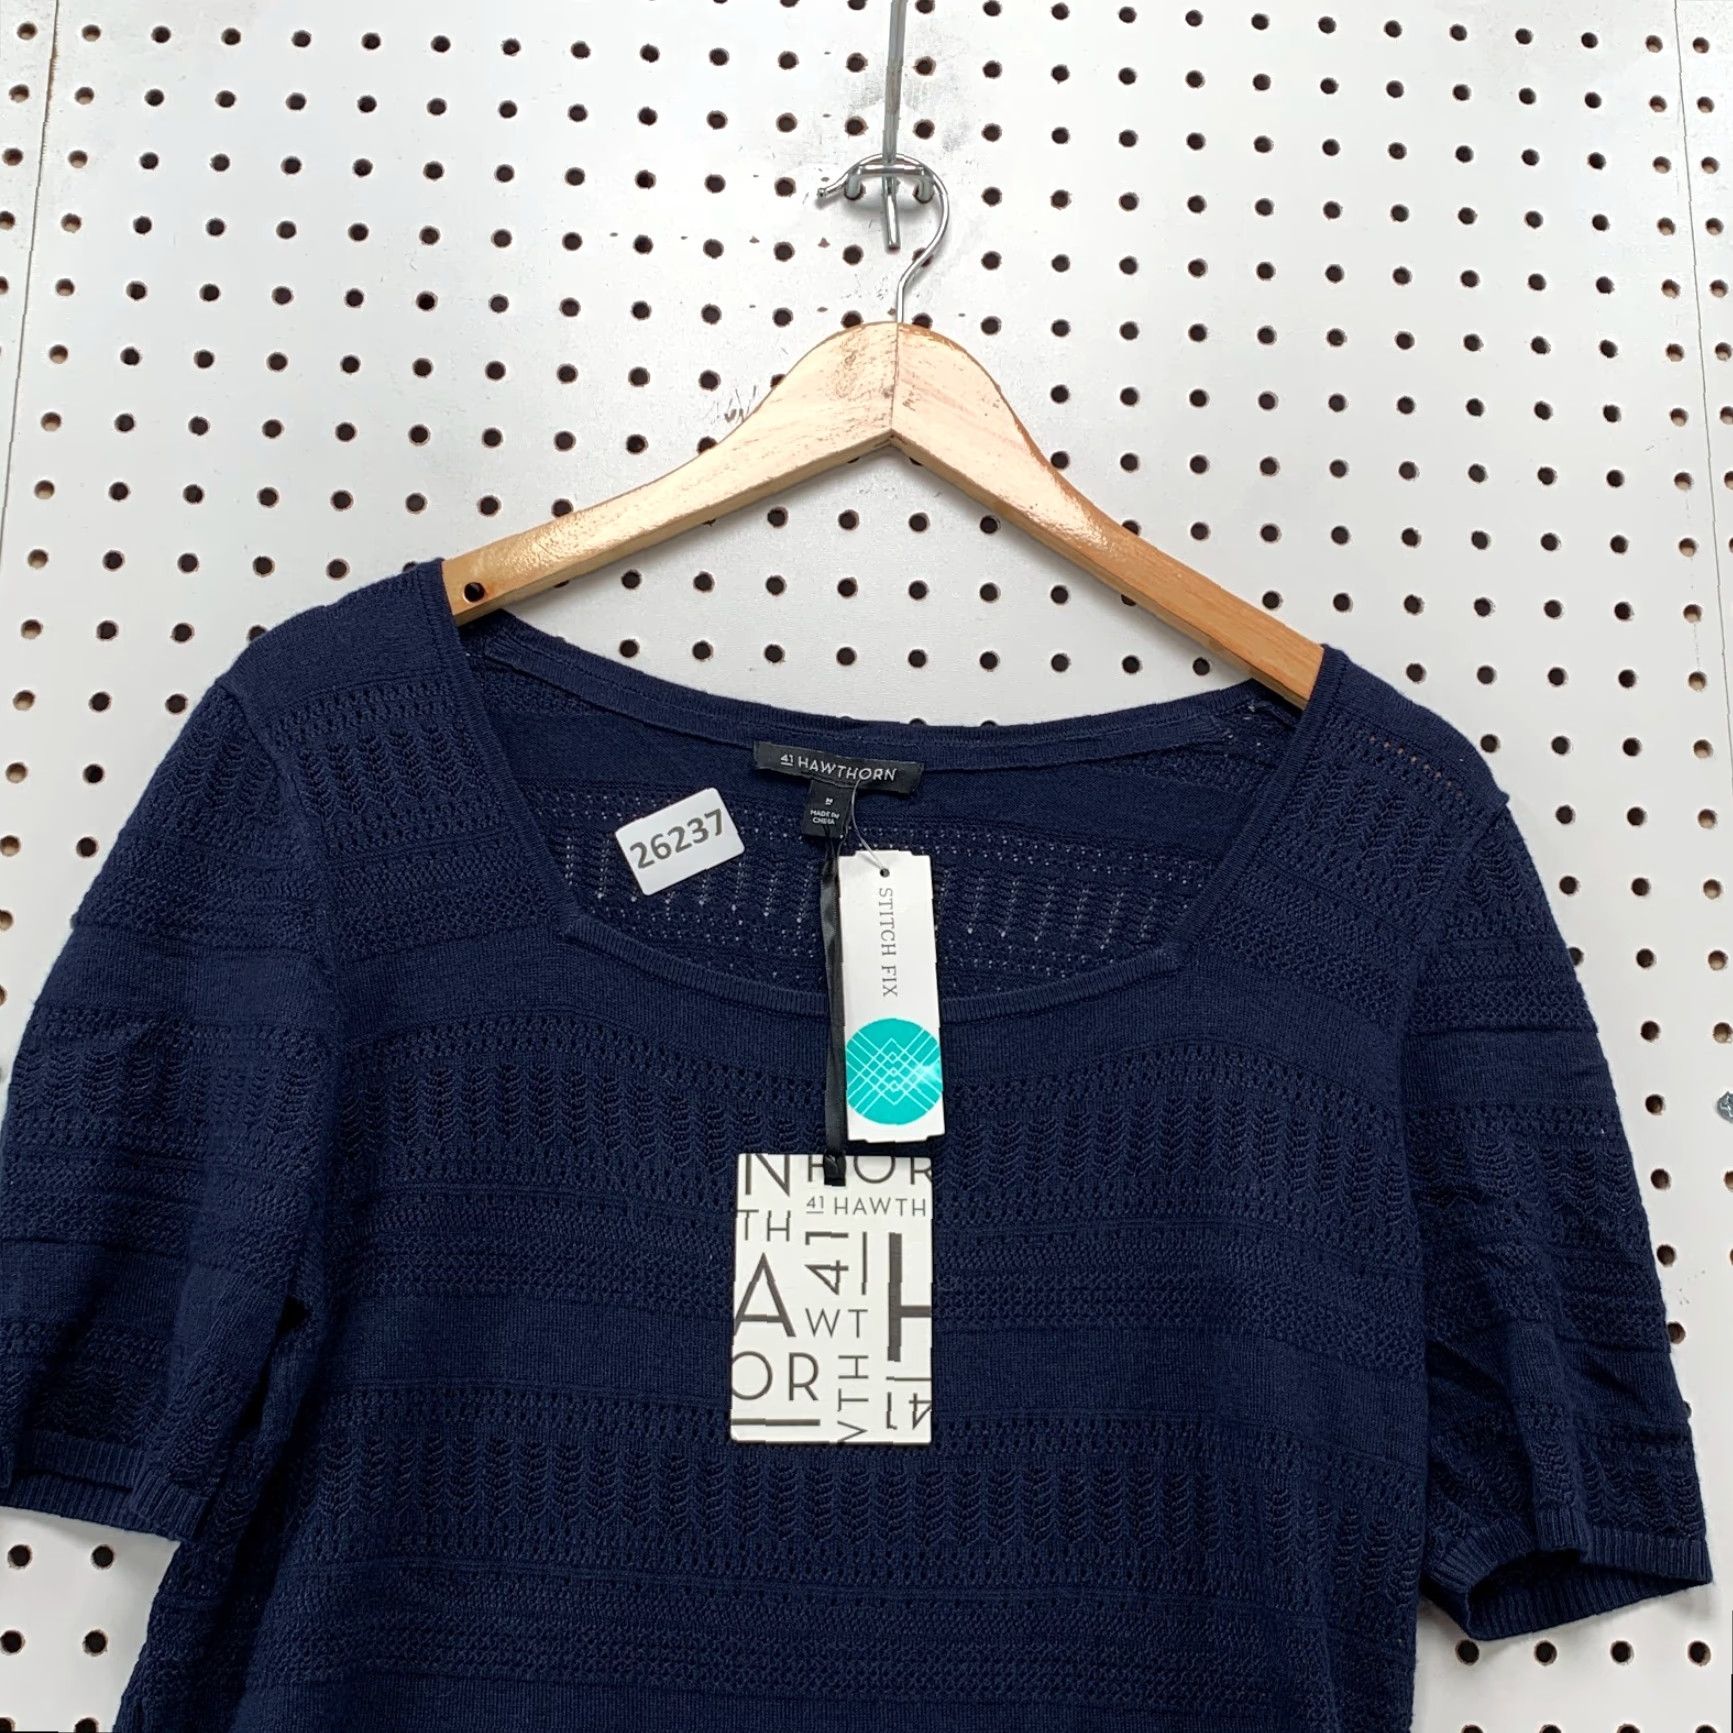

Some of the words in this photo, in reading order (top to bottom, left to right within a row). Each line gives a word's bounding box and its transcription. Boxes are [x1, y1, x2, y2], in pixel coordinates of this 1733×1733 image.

[780, 754, 794, 765] 41
[797, 756, 897, 782] HAWTHORN
[810, 809, 830, 818] MADE
[629, 808, 723, 870] 26237
[878, 887, 897, 956] STITCH
[881, 962, 898, 998] FIX
[806, 1195, 824, 1211] 41
[833, 1196, 926, 1217] HAWTH
[736, 1209, 792, 1242] TH
[734, 1251, 797, 1338] A
[805, 1308, 869, 1338] WT
[731, 1350, 820, 1401] OR
